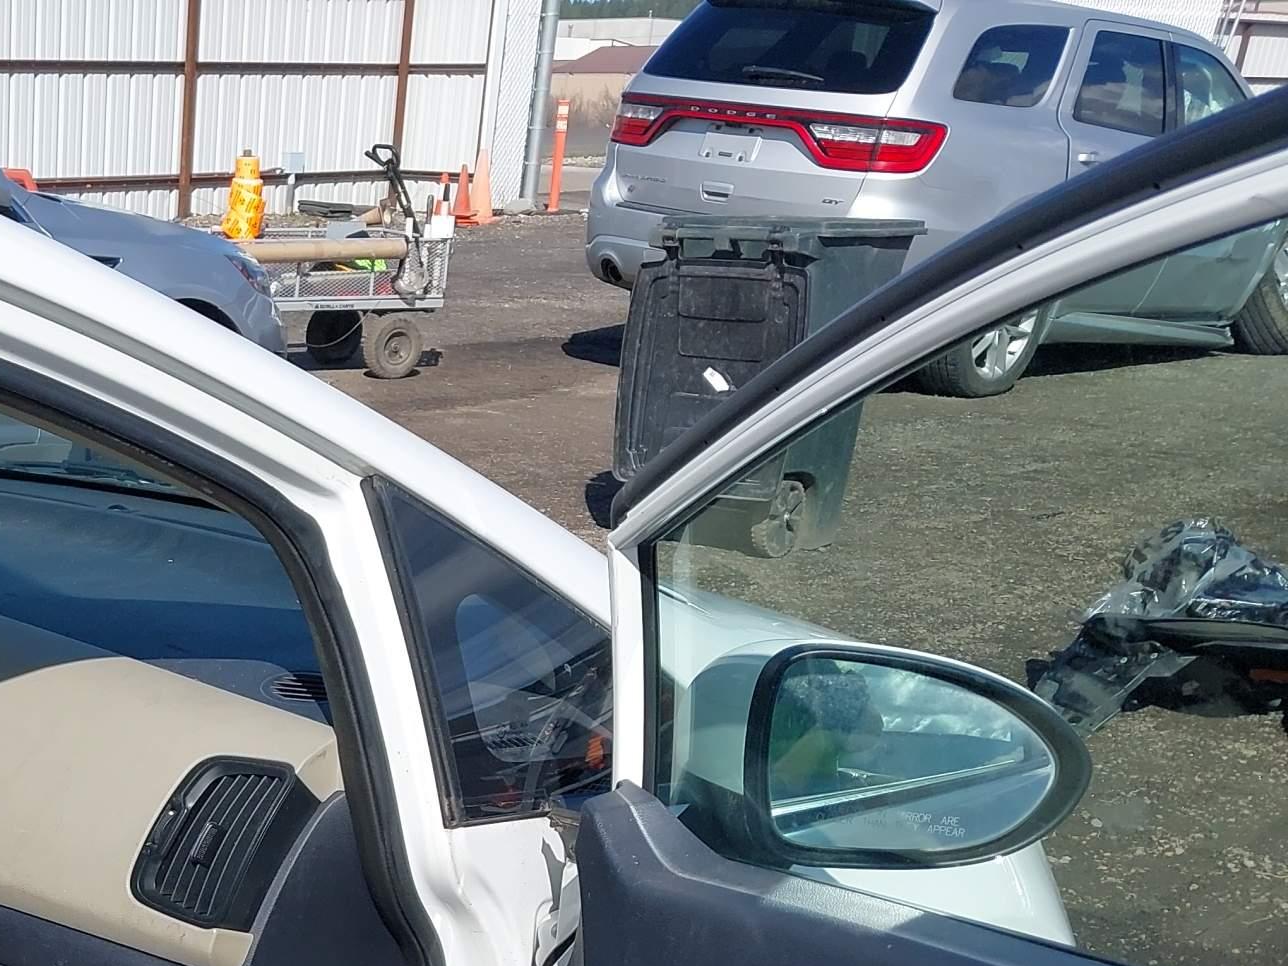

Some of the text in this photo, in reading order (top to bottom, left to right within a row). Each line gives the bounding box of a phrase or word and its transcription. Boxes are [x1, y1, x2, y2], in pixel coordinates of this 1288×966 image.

[690, 105, 777, 120] DODGE
[940, 816, 960, 827] ARE
[926, 825, 966, 838] APPEAR
